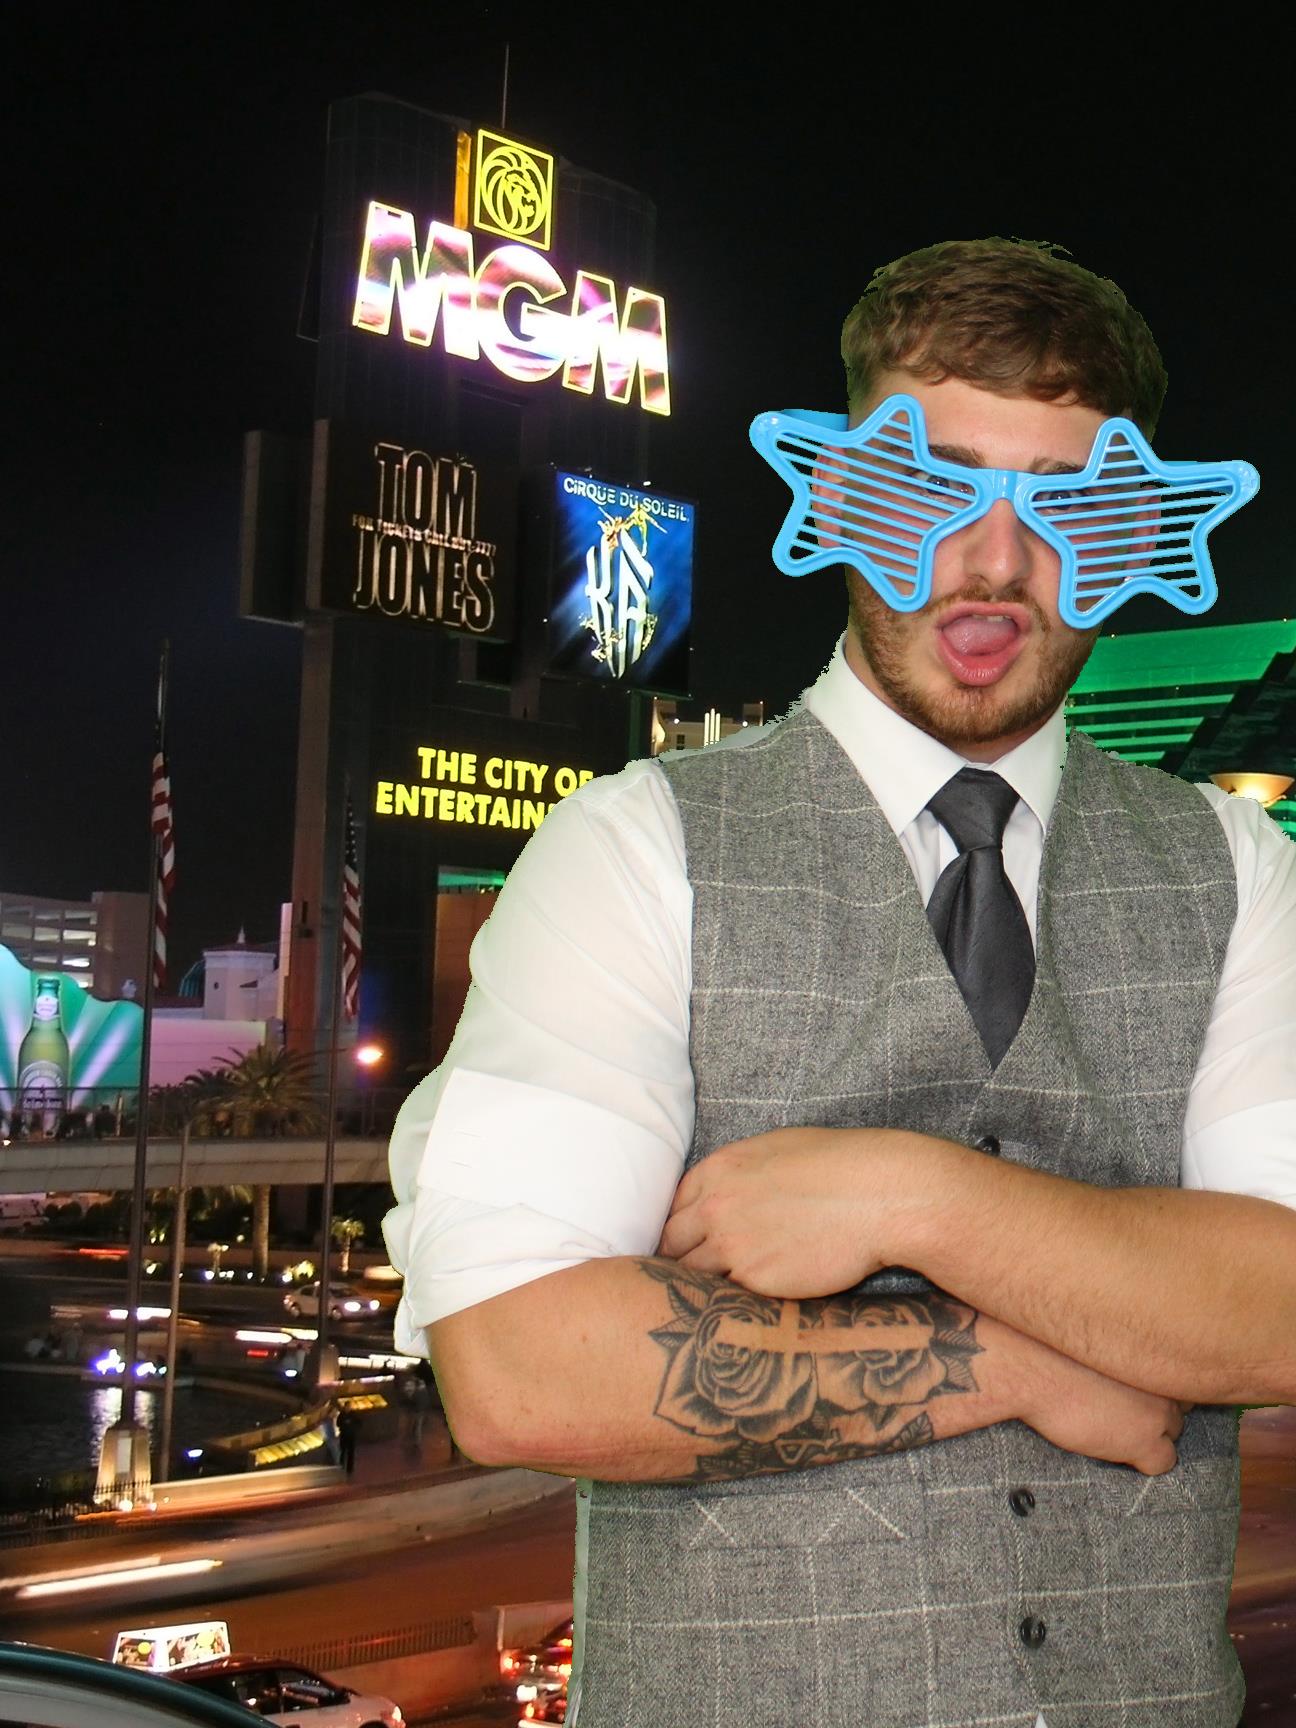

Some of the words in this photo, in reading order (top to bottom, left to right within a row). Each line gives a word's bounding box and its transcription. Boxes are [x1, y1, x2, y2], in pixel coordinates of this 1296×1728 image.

[353, 200, 671, 416] MGM
[374, 443, 477, 541] TOM
[563, 477, 616, 505] CIRQUE
[619, 492, 638, 509] DU
[640, 497, 687, 521] SOLEIL
[353, 528, 494, 632] JONES
[375, 781, 557, 830] ENTERTAIN
[417, 747, 478, 785] THE
[484, 757, 549, 794] CITY
